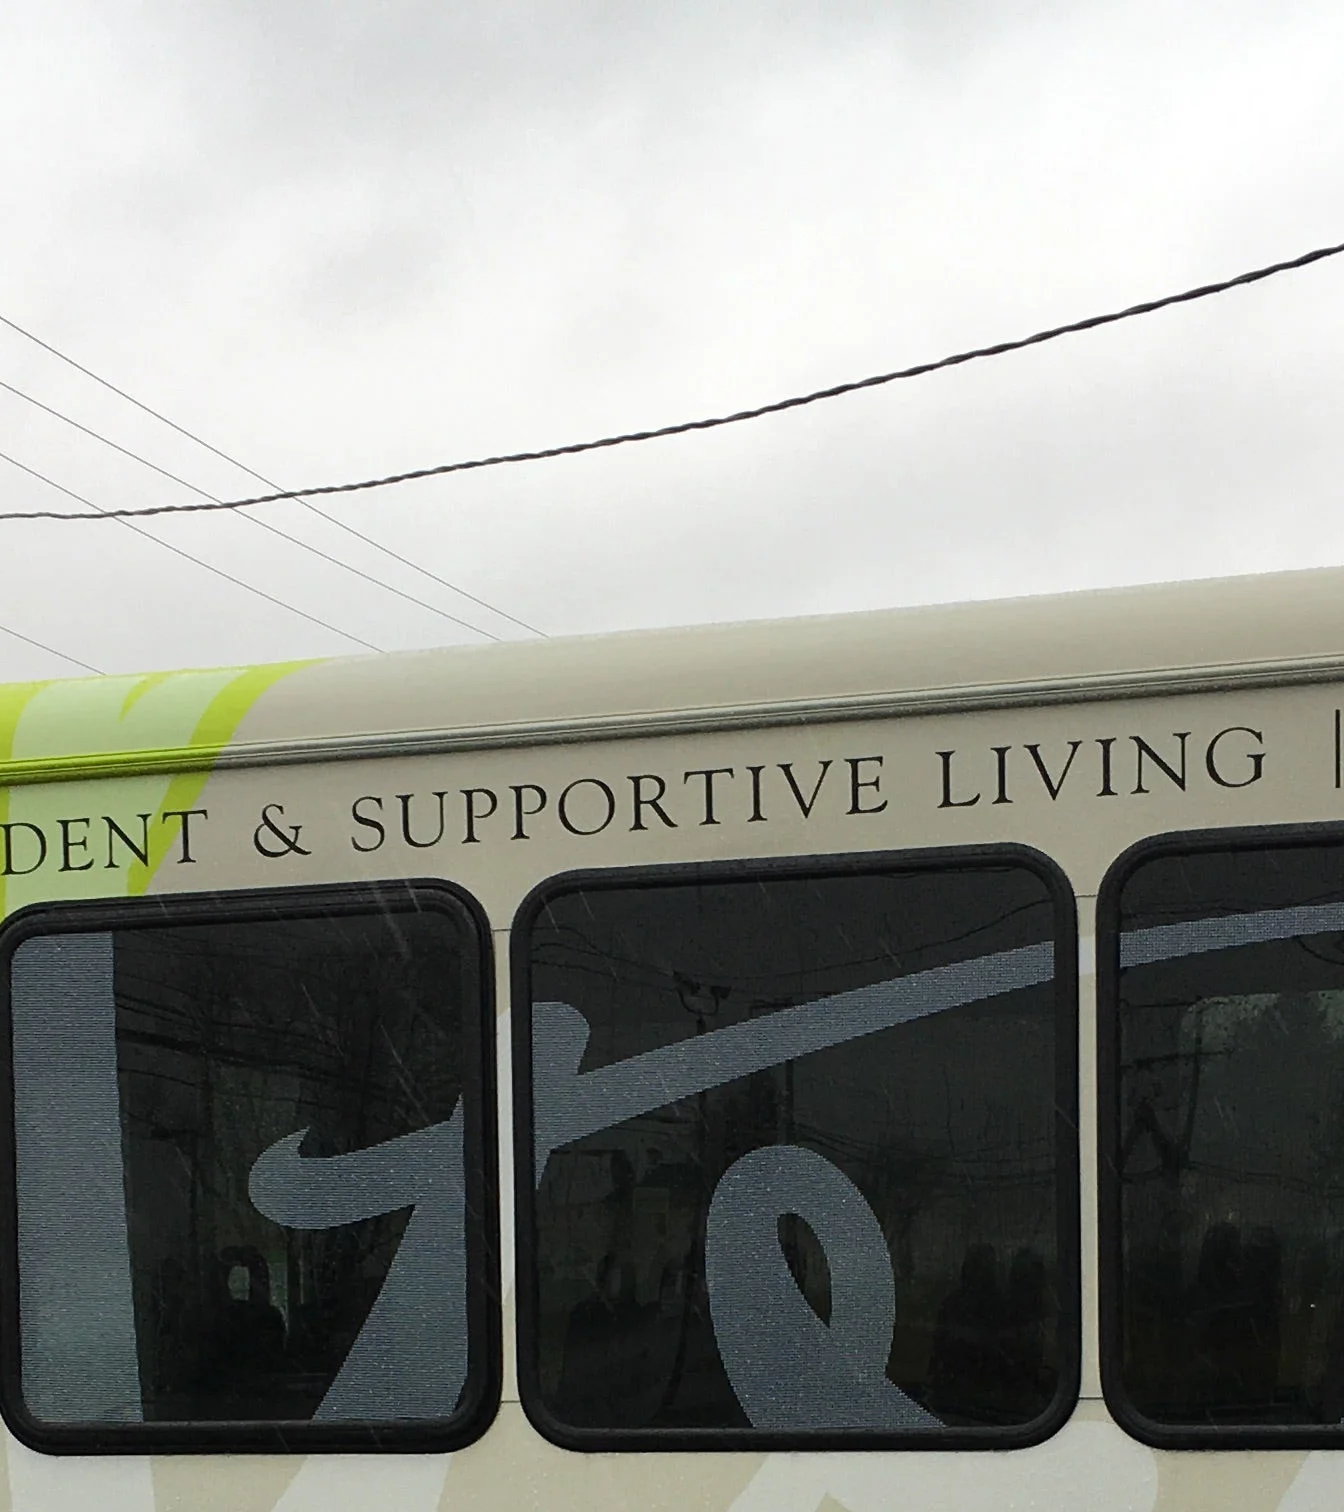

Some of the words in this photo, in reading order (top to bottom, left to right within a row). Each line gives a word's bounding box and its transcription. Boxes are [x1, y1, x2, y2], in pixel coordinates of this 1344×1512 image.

[252, 802, 313, 859] &
[350, 755, 889, 855] SUPPORTIVE
[934, 725, 1268, 811] LIVING
